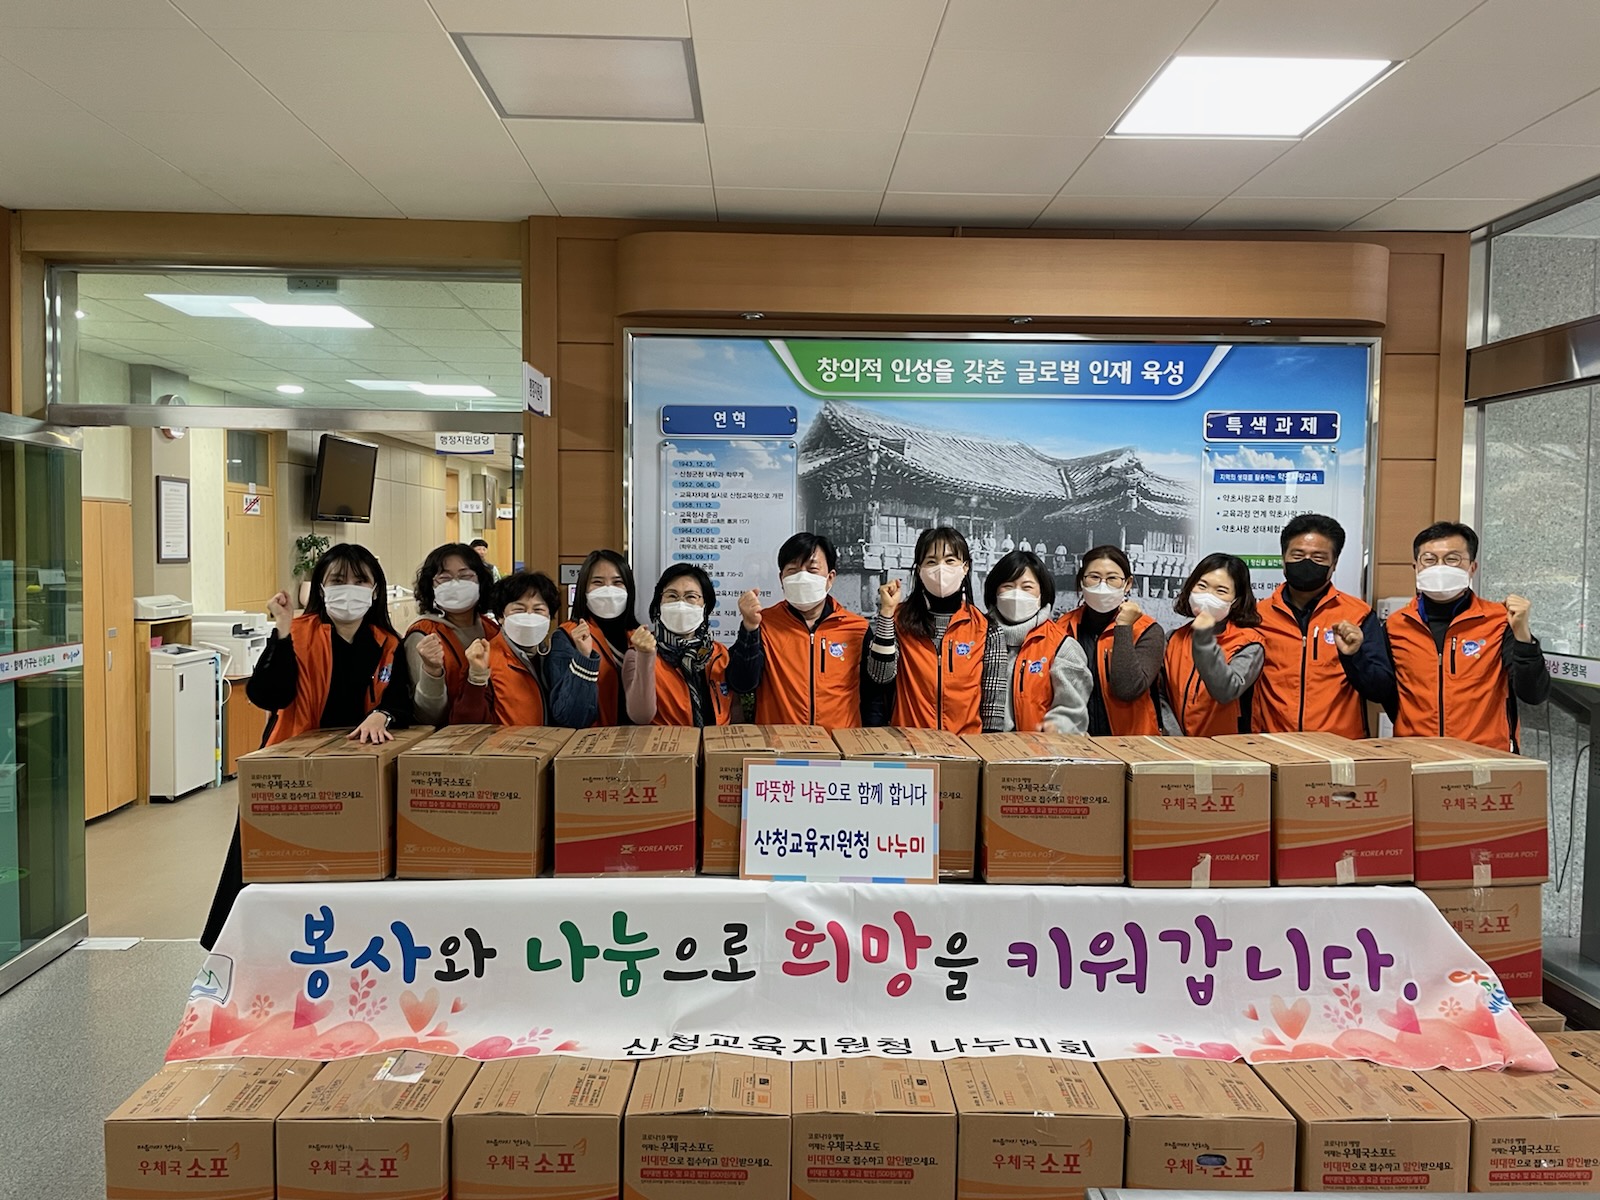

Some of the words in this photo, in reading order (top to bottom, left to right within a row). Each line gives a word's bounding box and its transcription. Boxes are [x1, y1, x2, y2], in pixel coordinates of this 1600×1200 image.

[816, 357, 882, 383] 창의적
[890, 357, 955, 384] 인성을
[963, 358, 1007, 385] 갖춘
[1015, 359, 1081, 385] 글로벌
[1088, 359, 1132, 385] 인재
[1140, 360, 1184, 386] 육성
[439, 435, 490, 445] 행정지원담당
[1222, 495, 1265, 503] 약초사랑교육
[1267, 495, 1282, 503] 환경
[1283, 495, 1298, 503] 조성
[1222, 510, 1251, 518] 교육과정
[1252, 510, 1267, 518] 연계
[1221, 525, 1250, 533] 약초사랑
[267, 780, 313, 789] 우체국소포도
[427, 777, 472, 787] 우체국소포도
[410, 788, 447, 798] 비대면으로
[448, 790, 476, 799] 접수하고
[756, 780, 795, 803] 따뜻한
[801, 780, 852, 804] 나눔으로
[858, 782, 883, 805] 함께
[889, 782, 927, 806] 합니다
[1017, 784, 1061, 792] 우체국소포도
[252, 792, 289, 801] 비대면으로
[290, 792, 317, 800] 접수하고
[583, 789, 620, 802] 우체국
[622, 786, 659, 805] 소포
[1001, 795, 1037, 804] 비대면으로
[1038, 795, 1065, 804] 접수하고
[1161, 797, 1197, 810] 우체국
[1201, 795, 1236, 812] 소포
[1442, 797, 1477, 810] 우체국
[1481, 794, 1515, 812] 소포
[664, 844, 684, 852] POST
[754, 828, 870, 859] 산청교육지원청
[877, 834, 925, 859] 나누미
[1360, 849, 1385, 857] KOREA
[1495, 851, 1520, 859] KOREA
[1453, 920, 1474, 932] 체국
[1478, 916, 1511, 934] 소포
[290, 905, 498, 999] 봉사와
[526, 911, 756, 998] 나눔으로
[781, 911, 979, 1002] 희망을
[1007, 915, 1419, 1006] 키워갑니다.
[1516, 971, 1533, 979] POST
[621, 1033, 912, 1057] 산청교육지원청
[930, 1035, 1096, 1058] 나누미회
[641, 1143, 659, 1151] 이제는
[660, 1142, 715, 1153] 우체국소포도
[808, 1142, 826, 1151] 이제는
[827, 1142, 880, 1152] 우체국소포도
[1509, 1145, 1561, 1155] 우체국소포도
[1343, 1148, 1397, 1158] 우체국소포도
[486, 1155, 530, 1170] 우체국
[534, 1153, 576, 1174] 소포
[641, 1155, 685, 1166] 비대면으로
[686, 1157, 718, 1166] 접수하고
[807, 1154, 850, 1165] 비대면으로
[852, 1156, 884, 1166] 접수하고
[992, 1154, 1036, 1170] 우체국
[1039, 1153, 1082, 1174] 소포
[1490, 1158, 1531, 1167] 비대면으로
[137, 1160, 181, 1176] 우체국
[186, 1157, 230, 1178] 소포
[308, 1160, 351, 1176] 우체국
[356, 1157, 399, 1178] 소포
[1323, 1161, 1367, 1172] 비대면으로
[1369, 1162, 1401, 1172] 접수하고
